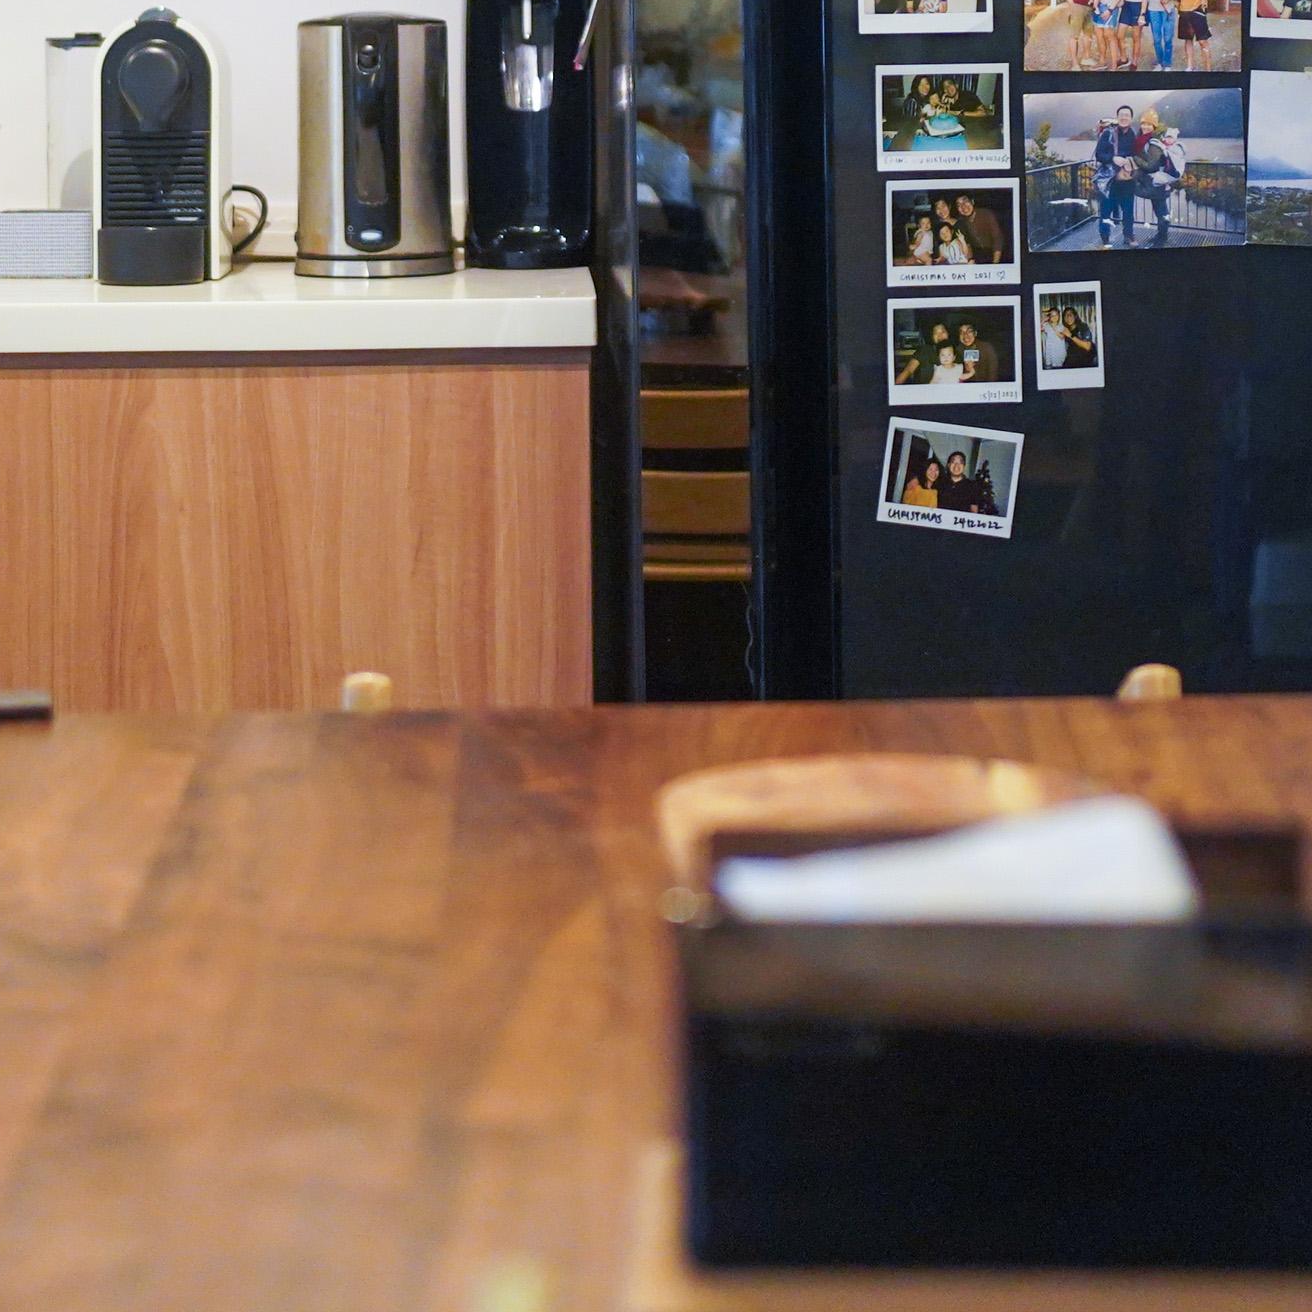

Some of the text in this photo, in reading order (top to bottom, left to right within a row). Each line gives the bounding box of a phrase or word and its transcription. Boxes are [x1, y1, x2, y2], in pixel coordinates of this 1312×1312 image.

[899, 272, 947, 281] CHRISTMAS
[952, 272, 967, 280] DAY
[888, 508, 943, 524] CHRISTMAS
